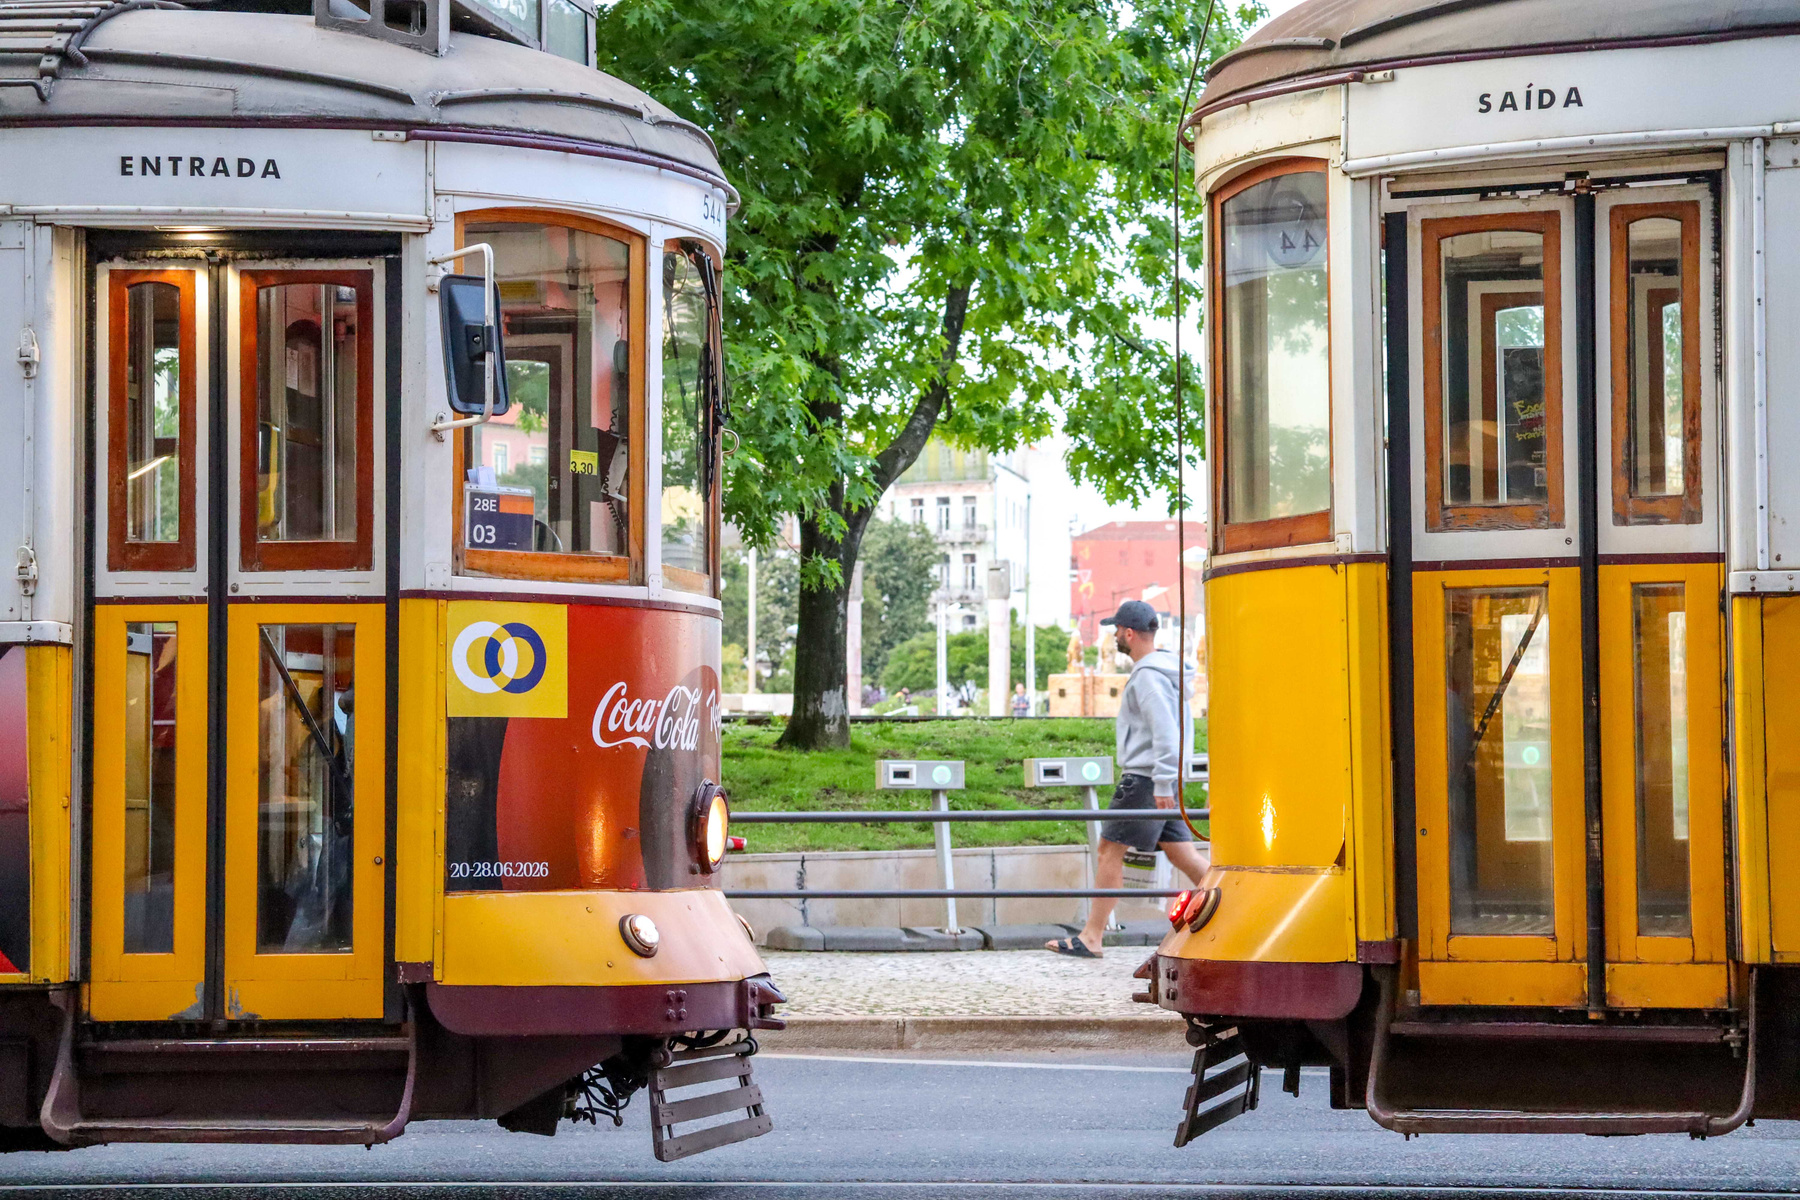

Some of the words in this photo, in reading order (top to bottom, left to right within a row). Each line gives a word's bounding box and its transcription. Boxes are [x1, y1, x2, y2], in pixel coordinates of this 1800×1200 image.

[1478, 82, 1584, 114] SAÍDA
[120, 156, 281, 179] ENTRADA
[703, 193, 721, 228] 544
[474, 498, 497, 512] 28E
[473, 524, 496, 544] 03
[592, 681, 702, 751] Coca-Cola
[450, 861, 549, 878] 20-28.06.2026
